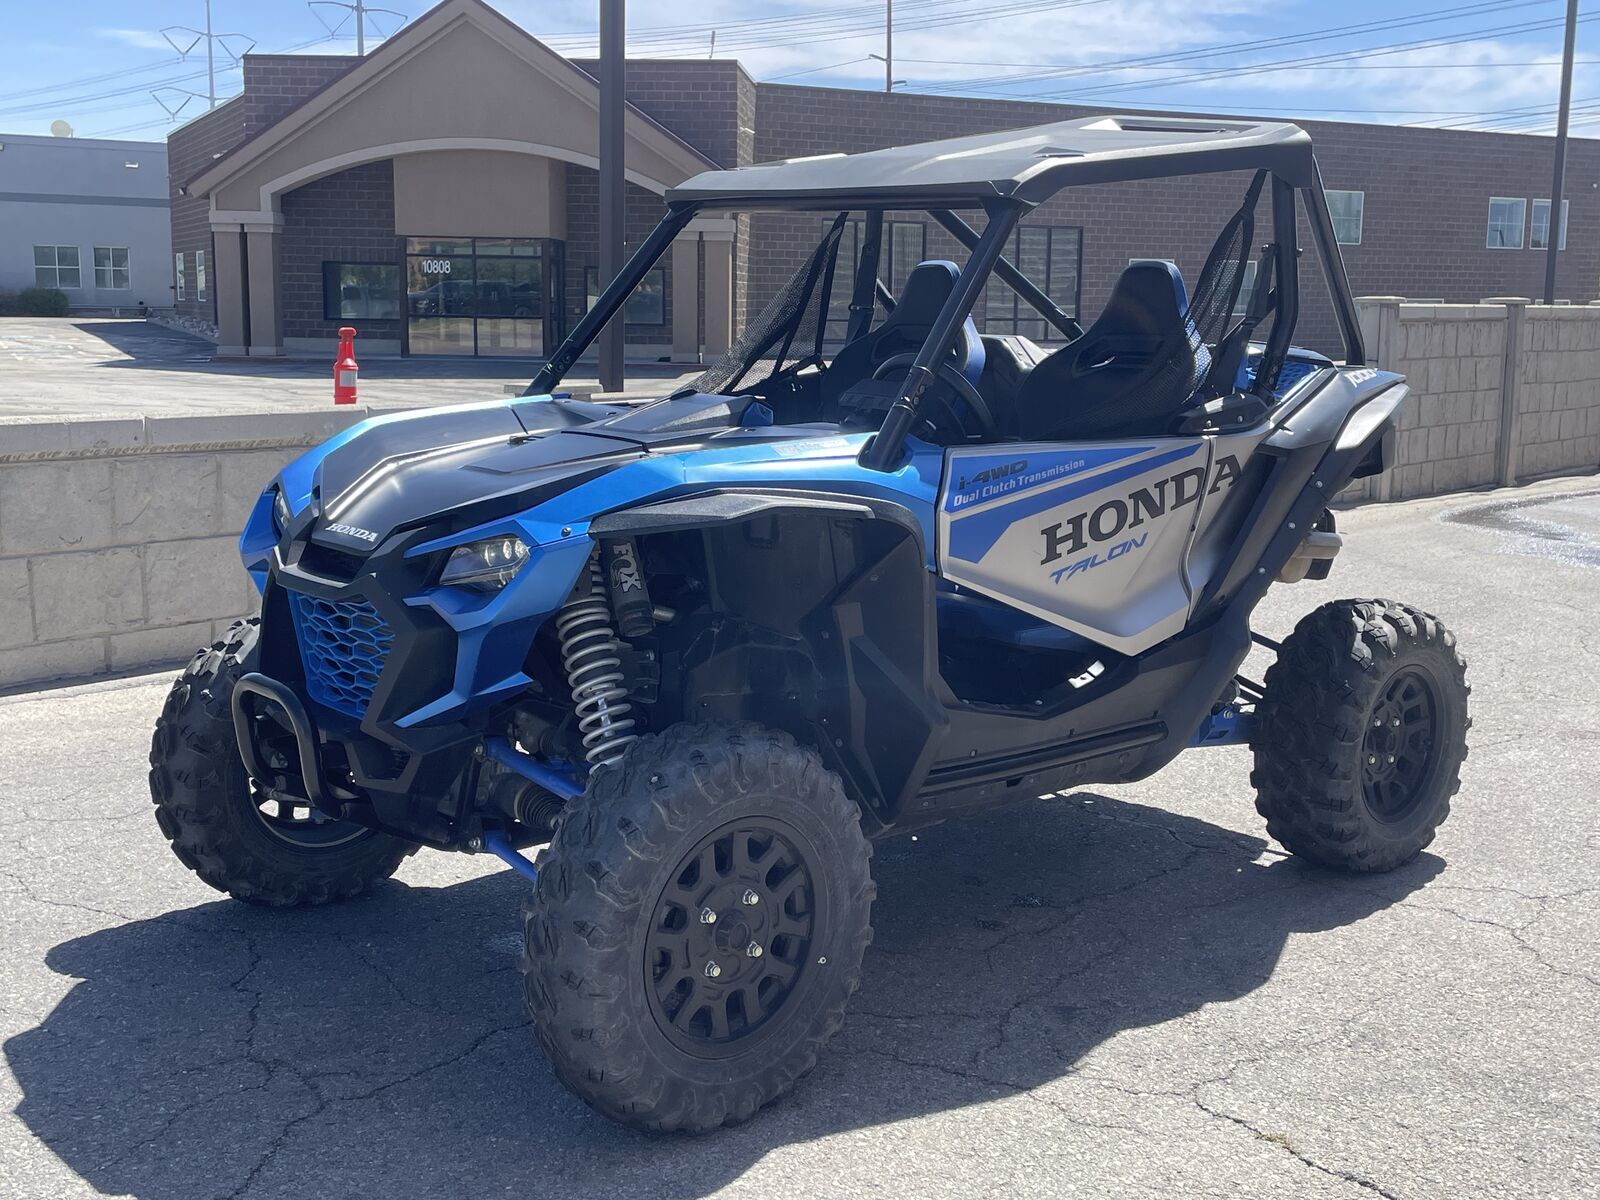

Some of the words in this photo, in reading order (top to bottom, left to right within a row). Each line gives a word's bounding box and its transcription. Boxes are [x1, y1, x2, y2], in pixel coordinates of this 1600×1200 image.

[422, 259, 451, 274] 10808
[953, 489, 979, 507] Dual
[982, 474, 1016, 497] Clutch
[1017, 459, 1085, 486] Transmission
[325, 522, 379, 542] HONDA
[1040, 454, 1242, 566] HONDA
[610, 542, 642, 593] FOX
[1049, 532, 1148, 585] TALON
